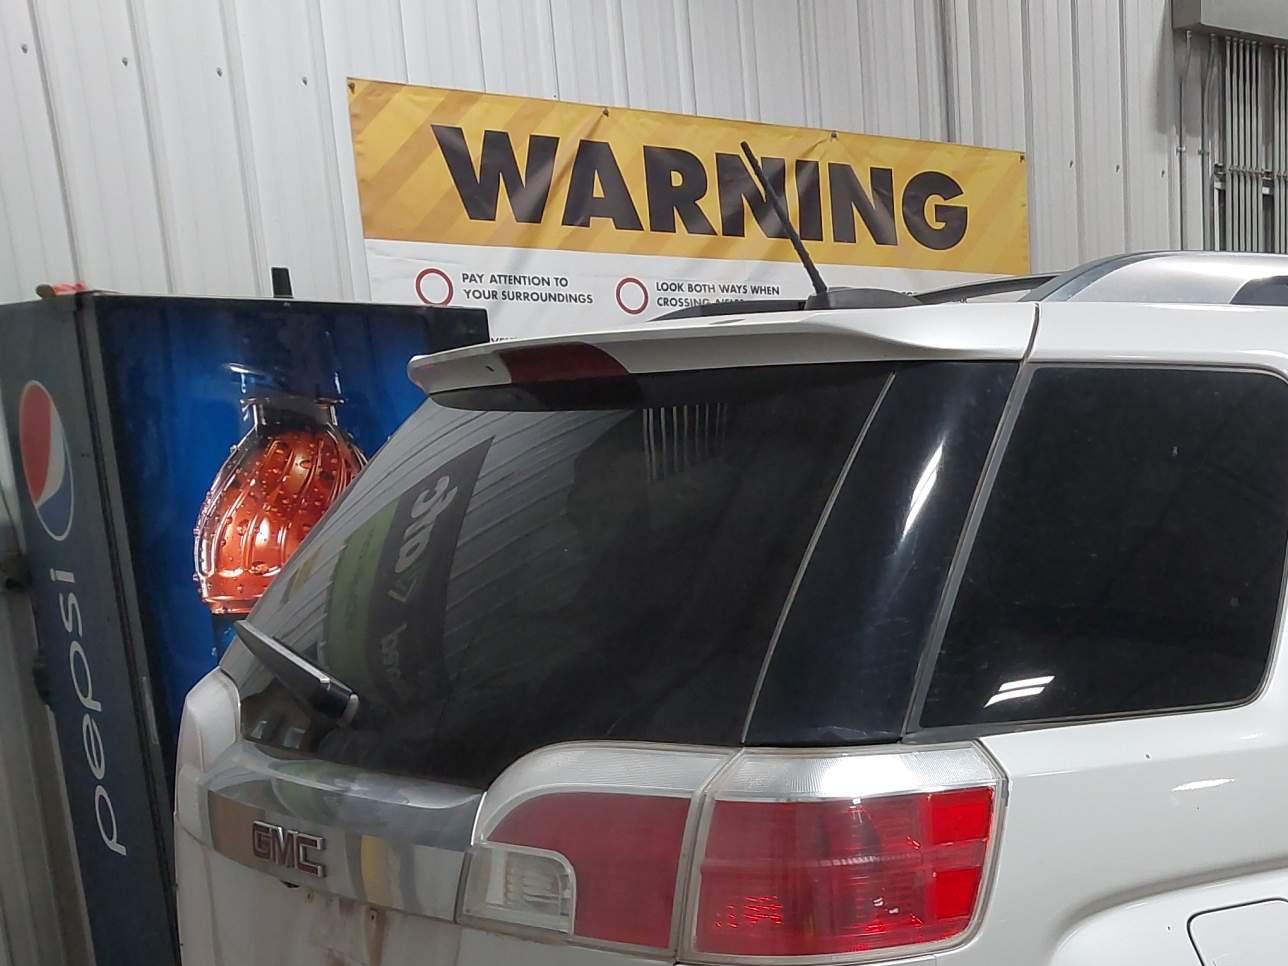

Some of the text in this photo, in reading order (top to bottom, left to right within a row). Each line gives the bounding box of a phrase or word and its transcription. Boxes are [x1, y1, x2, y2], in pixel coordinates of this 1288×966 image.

[430, 124, 968, 251] WARNING
[461, 273, 569, 288] PAY ATTENTION TO
[463, 289, 594, 304] YOUR SURROUNDINGS
[656, 281, 780, 296] LOOK BOTH WAYS WHEN
[50, 567, 127, 857] pepsi
[252, 820, 326, 878] GMC
